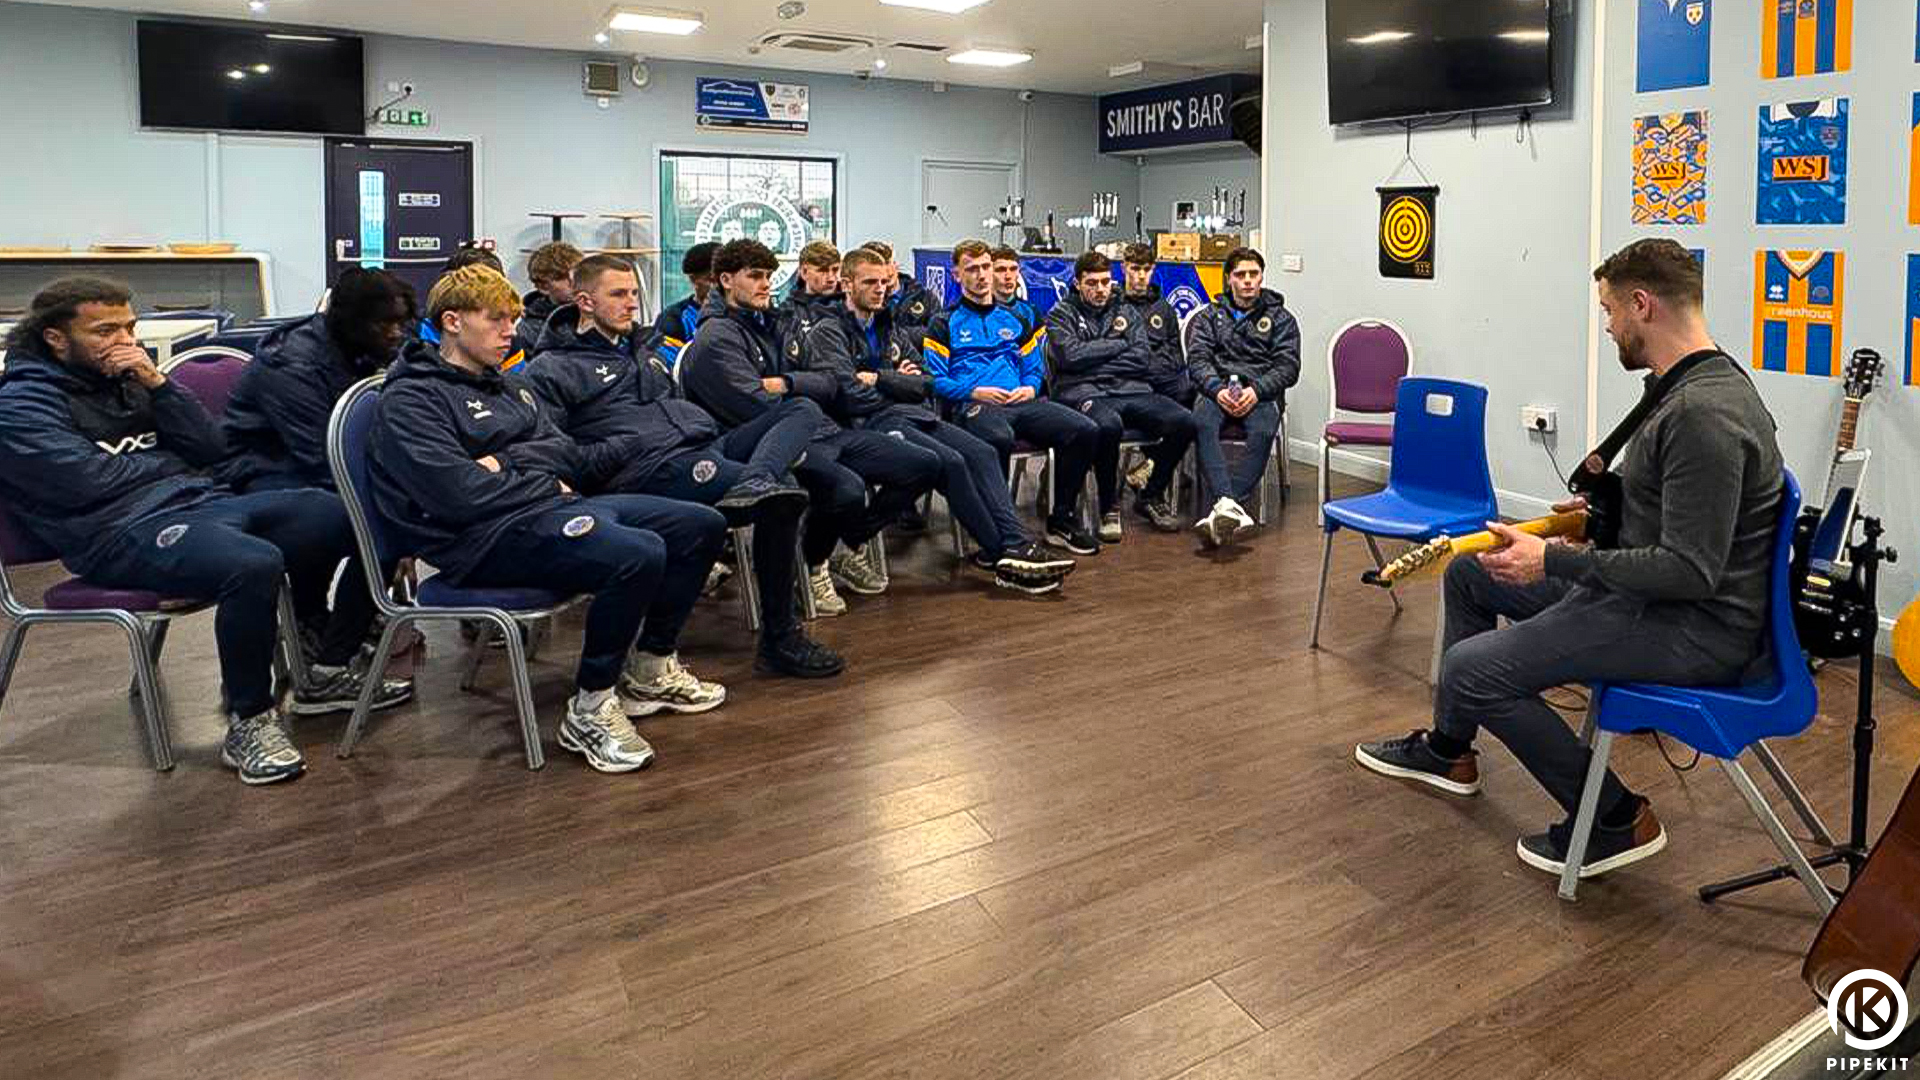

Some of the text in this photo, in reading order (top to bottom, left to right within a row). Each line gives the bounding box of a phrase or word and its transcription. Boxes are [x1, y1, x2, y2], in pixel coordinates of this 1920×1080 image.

[1107, 94, 1224, 137] SMITHY'S BAR
[1652, 162, 1687, 179] WSJ
[1775, 156, 1827, 180] WSJ
